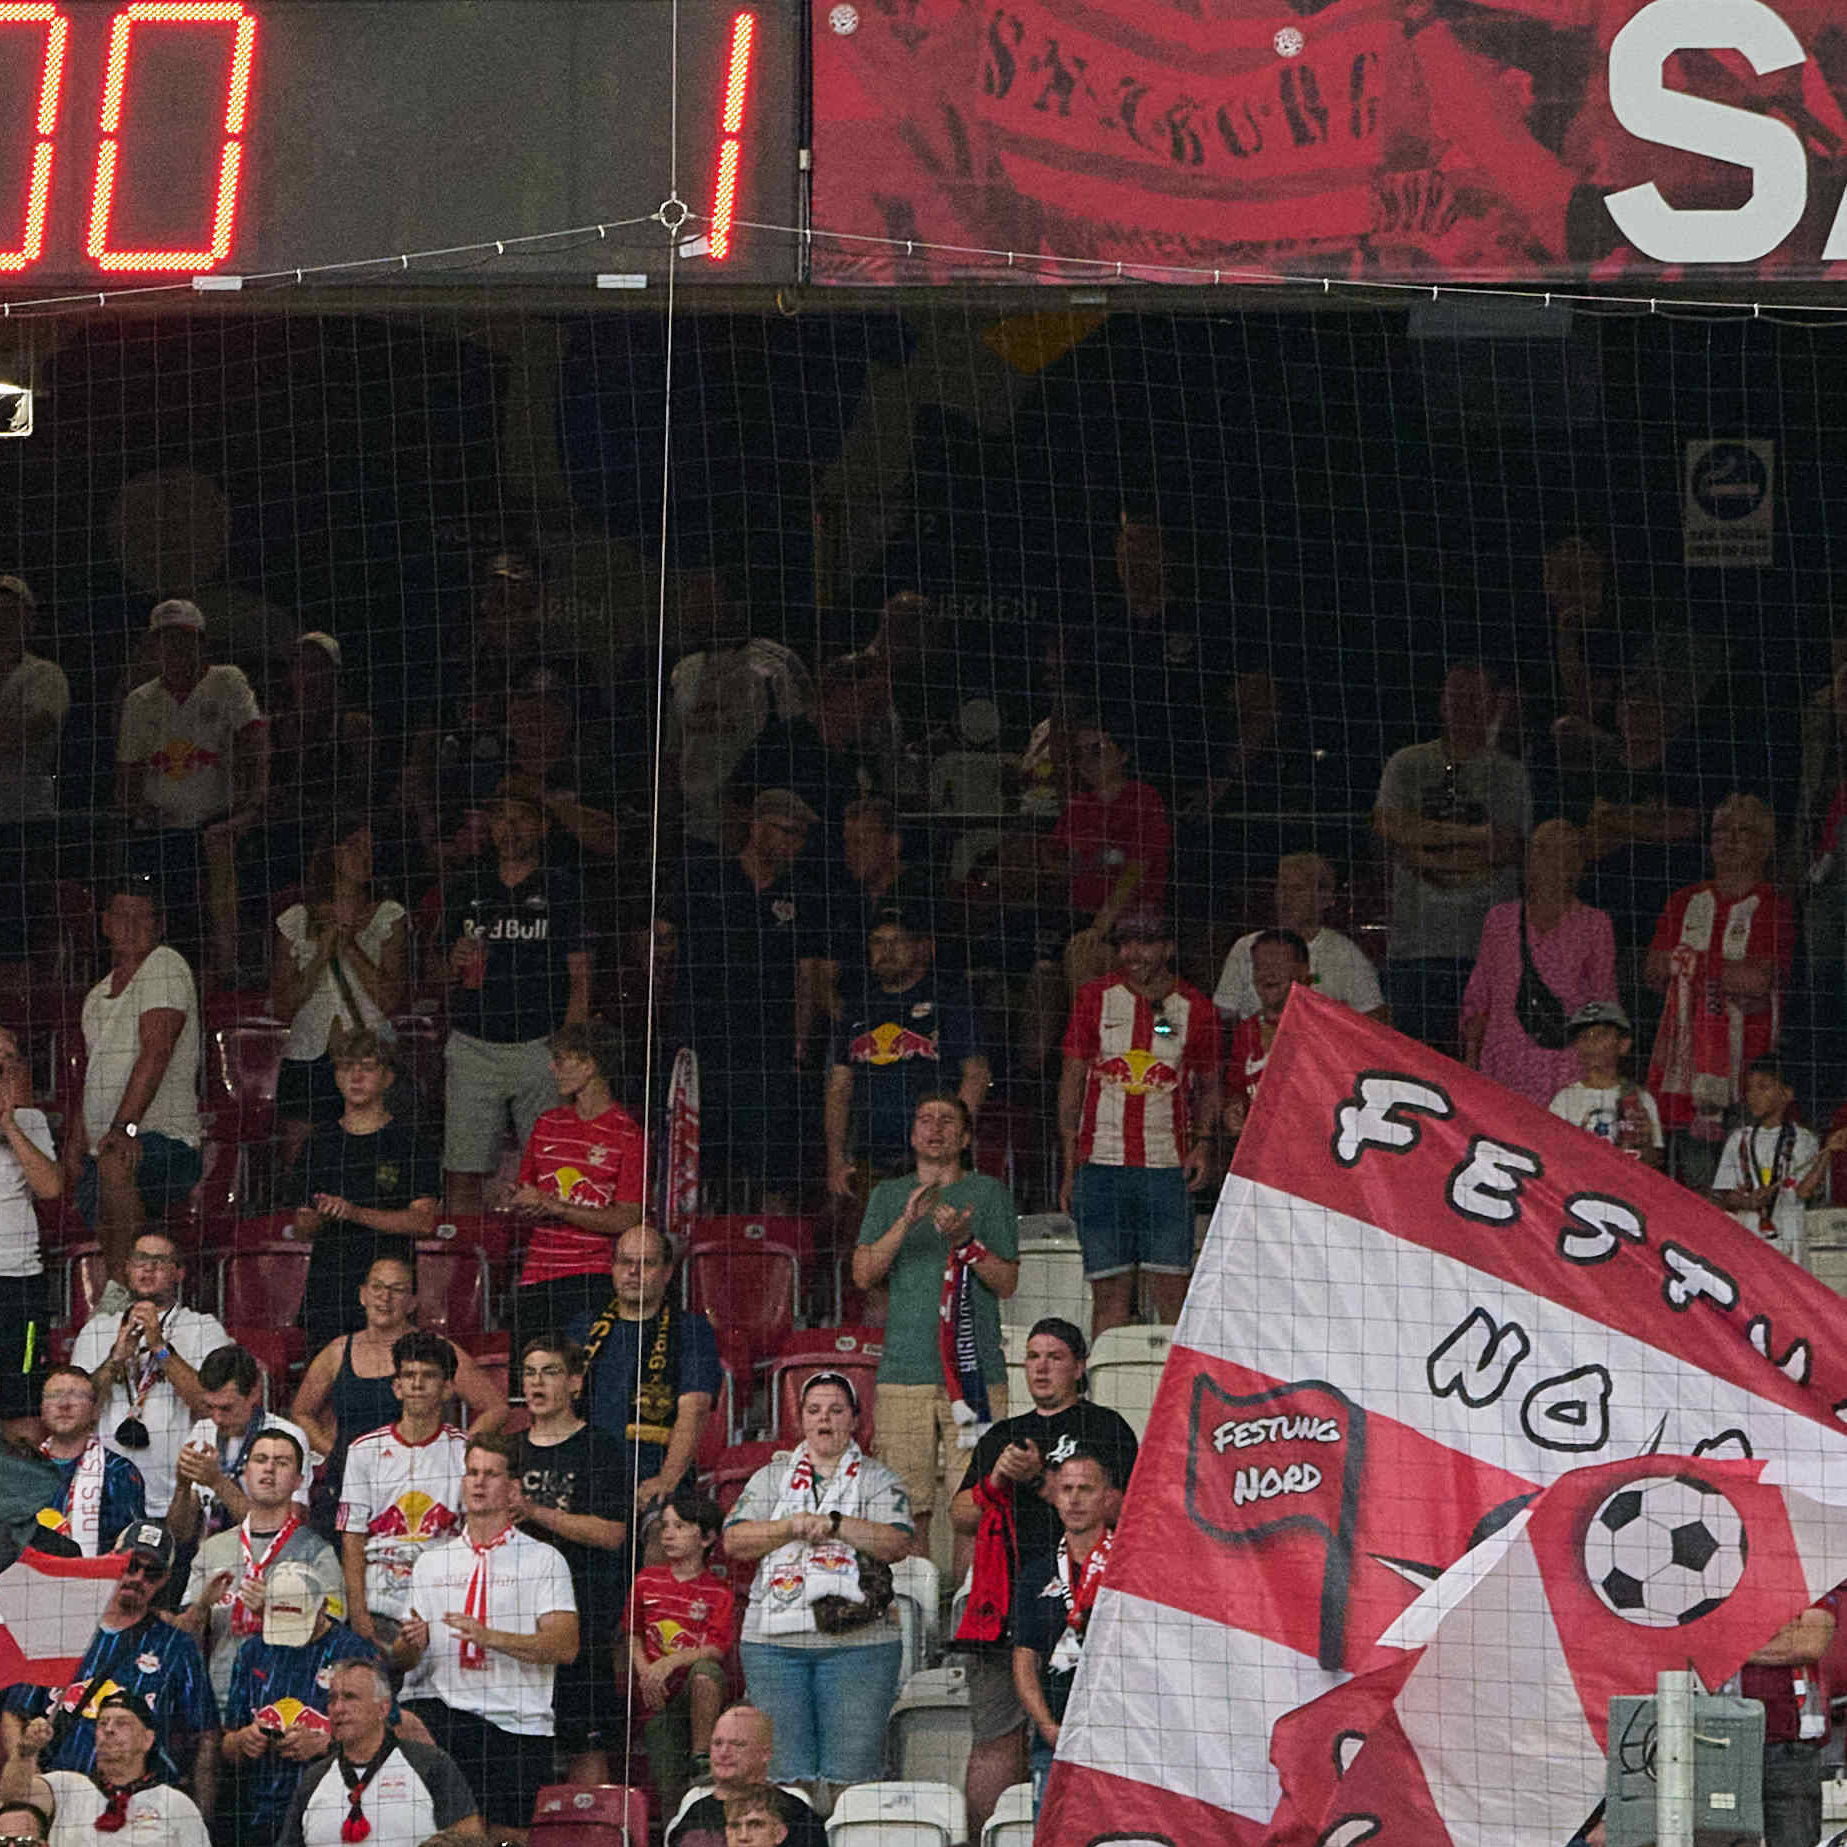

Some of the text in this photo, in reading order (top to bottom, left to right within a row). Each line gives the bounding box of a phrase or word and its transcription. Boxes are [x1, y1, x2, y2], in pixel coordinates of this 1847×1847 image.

[707, 12, 754, 260] 1
[1604, 0, 1847, 262] S
[1212, 1415, 1341, 1455] FESTUNG
[1234, 1462, 1324, 1508] NORD
